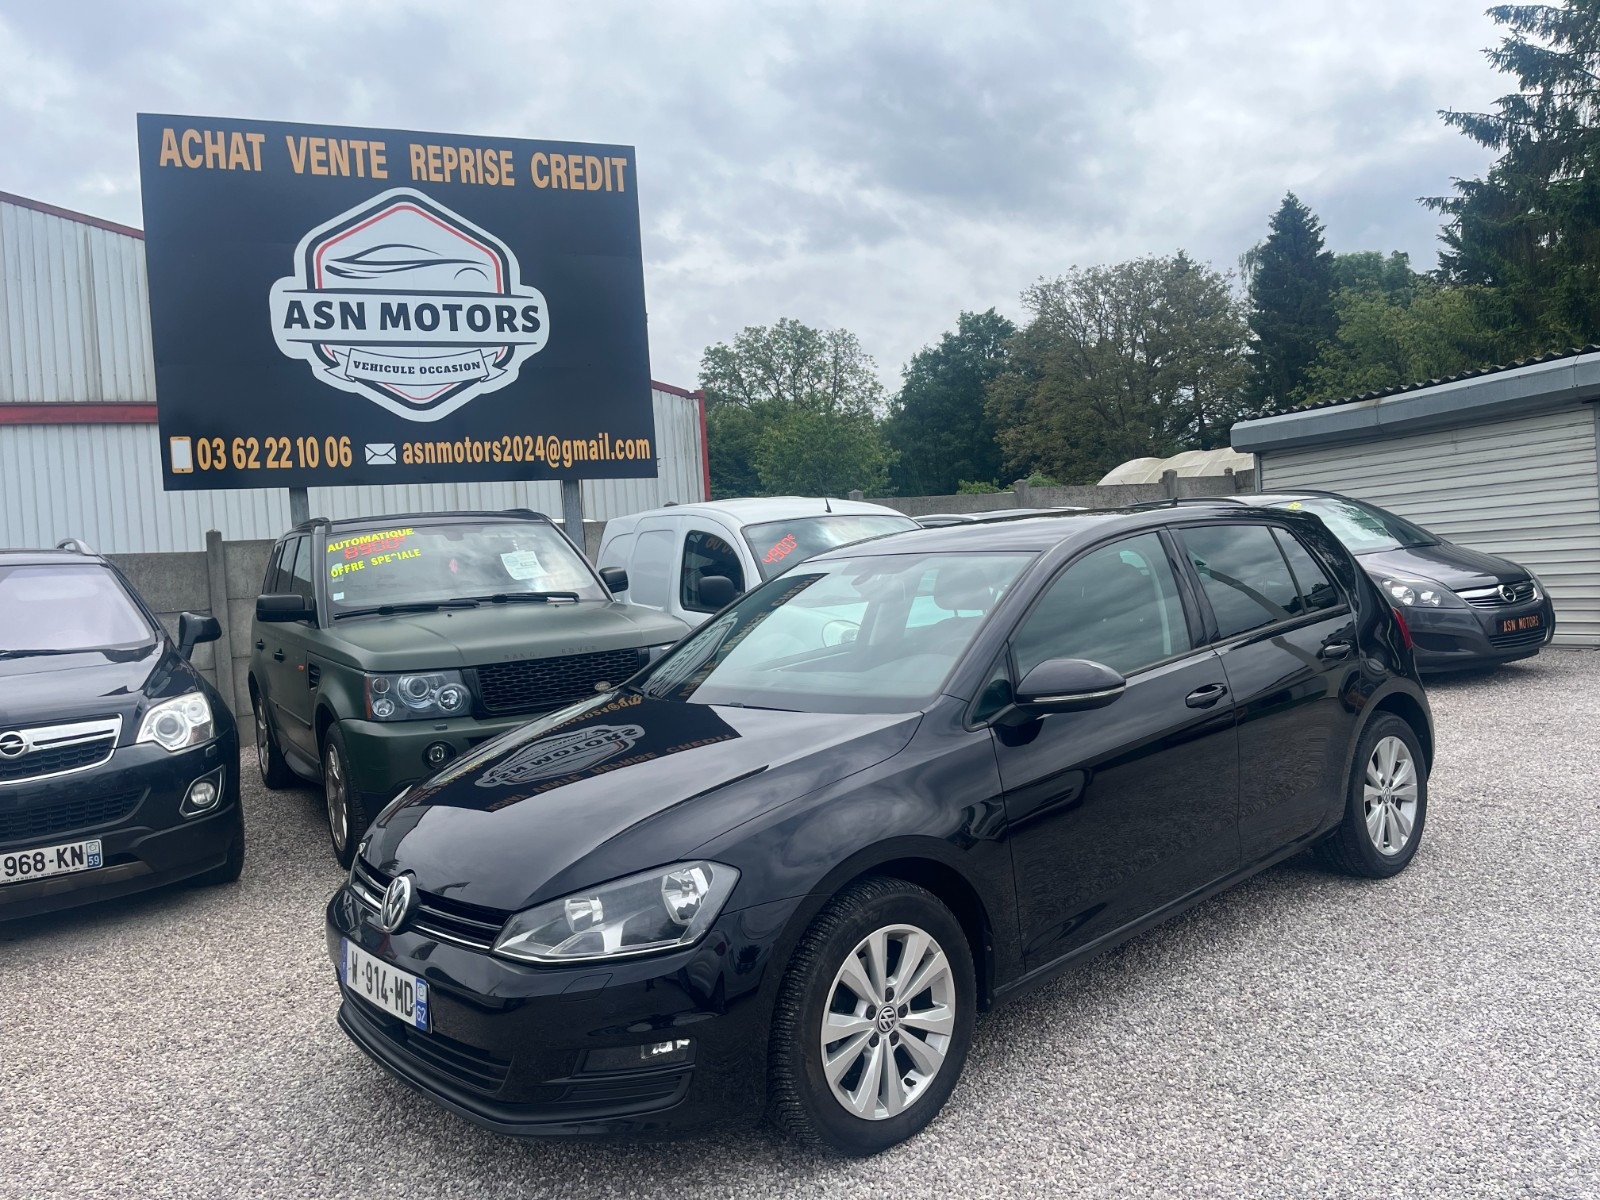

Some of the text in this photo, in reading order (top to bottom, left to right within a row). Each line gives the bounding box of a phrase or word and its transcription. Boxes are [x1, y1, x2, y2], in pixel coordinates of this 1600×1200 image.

[159, 127, 628, 193] ACHAT VENTE REPRISE CREDIT
[283, 299, 541, 333] ASN MOTORS
[353, 360, 481, 375] VEHICULE OCCASION
[197, 435, 353, 471] 03 62 22 10 06
[402, 432, 651, 468] asnmotors2024@gmail.com
[327, 528, 415, 553] AUTOMATIQUE
[330, 548, 421, 578] OFFRE SPEIALE
[88, 855, 100, 866] 59
[416, 1004, 426, 1025] 62
